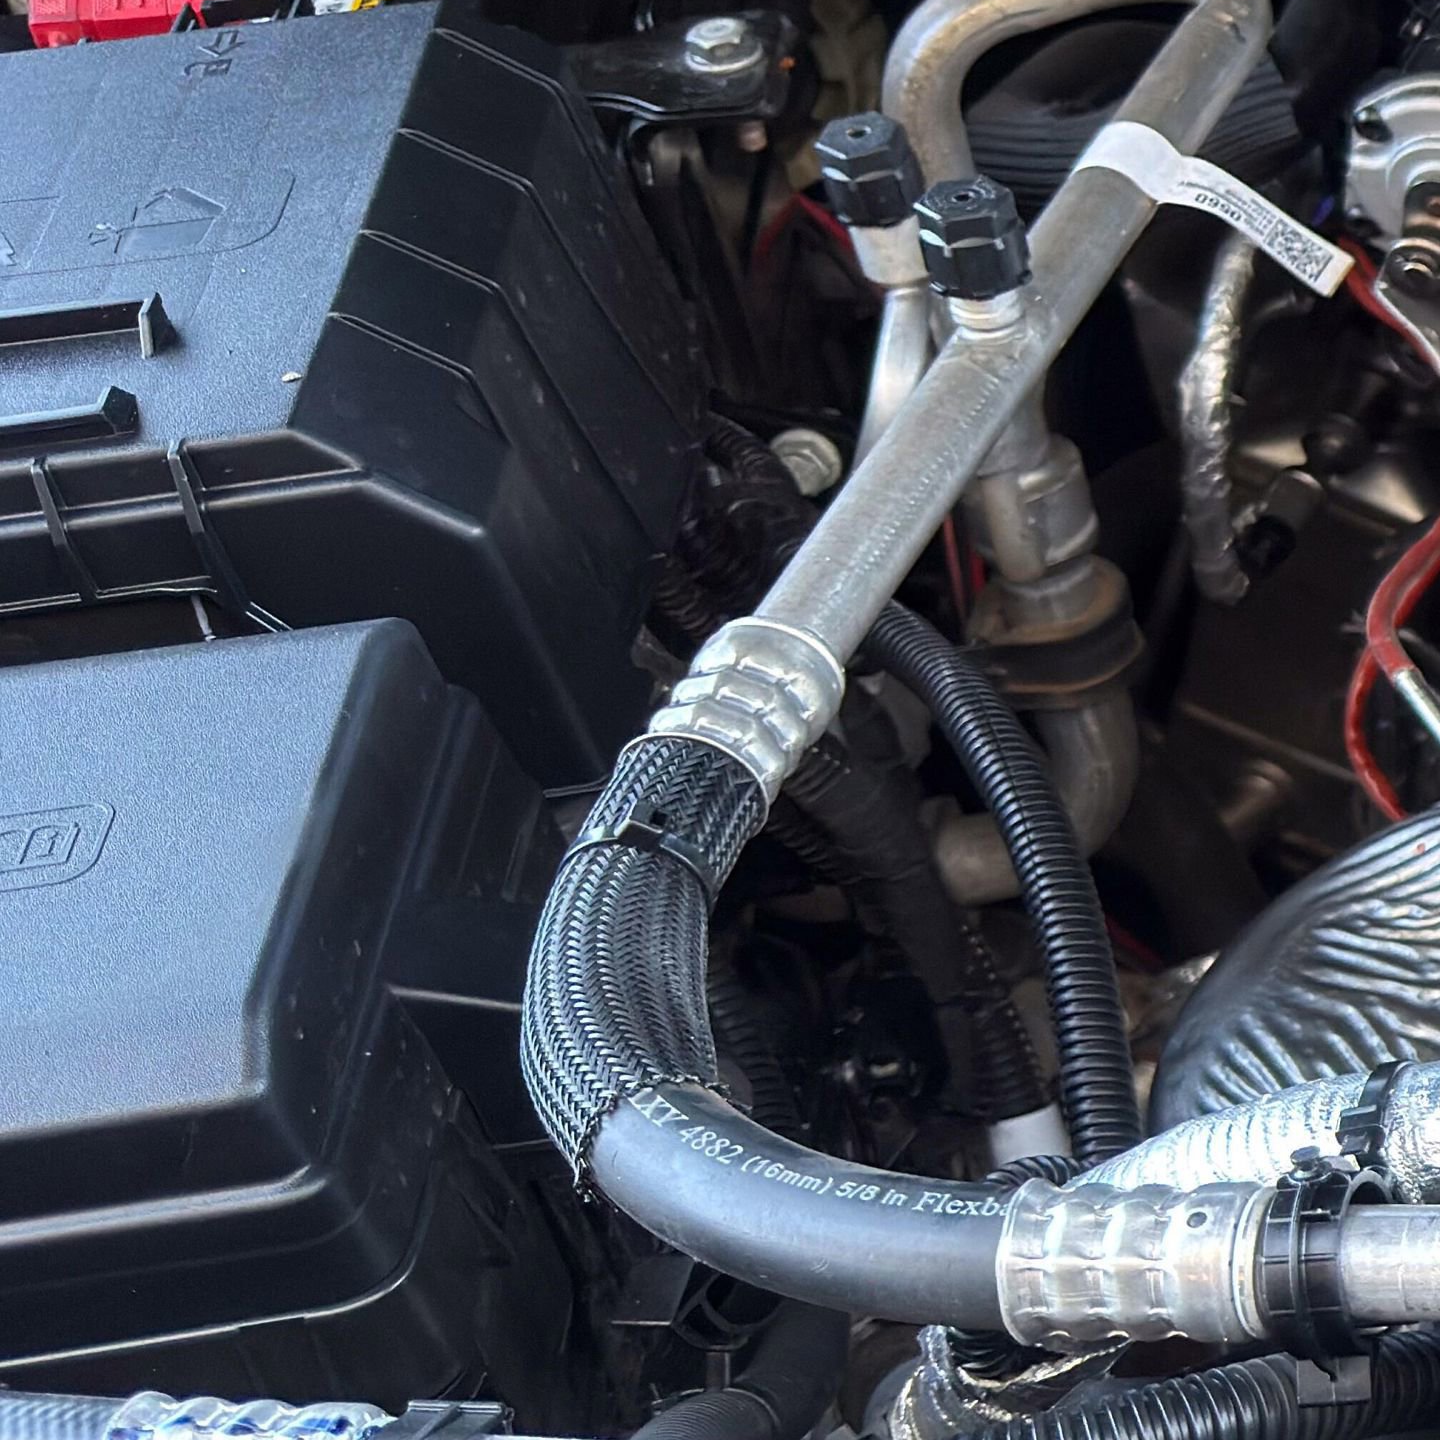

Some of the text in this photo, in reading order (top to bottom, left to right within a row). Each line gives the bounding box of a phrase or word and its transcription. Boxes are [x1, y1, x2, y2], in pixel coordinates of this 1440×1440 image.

[679, 1124, 744, 1166] 4882
[740, 1155, 835, 1196] (16mm)
[835, 1181, 881, 1203] 5/8
[881, 1187, 909, 1208] in
